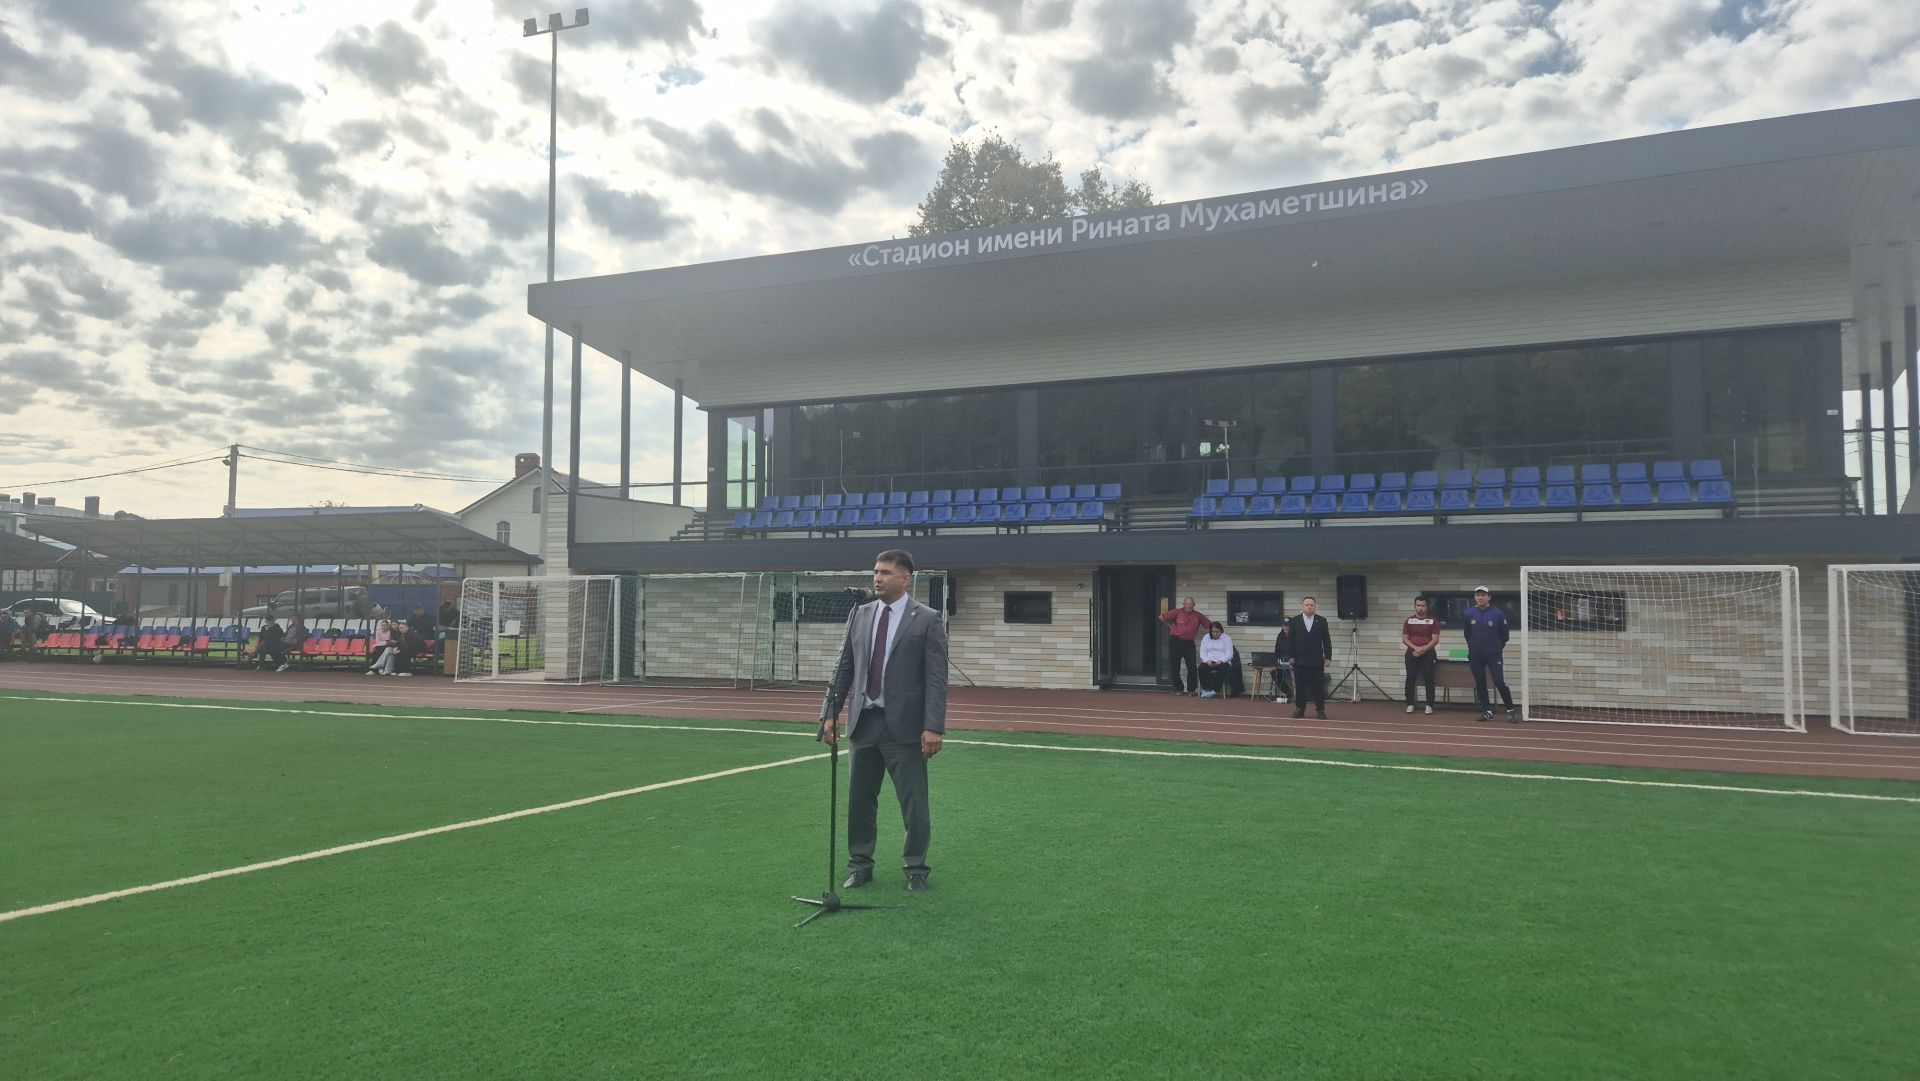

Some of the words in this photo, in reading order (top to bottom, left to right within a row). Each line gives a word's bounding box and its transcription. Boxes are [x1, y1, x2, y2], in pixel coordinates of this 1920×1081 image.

[849, 238, 969, 267] «Стадион
[977, 226, 1063, 254] имени
[1071, 213, 1171, 242] Рината
[1179, 179, 1429, 231] Мухаметшина»
